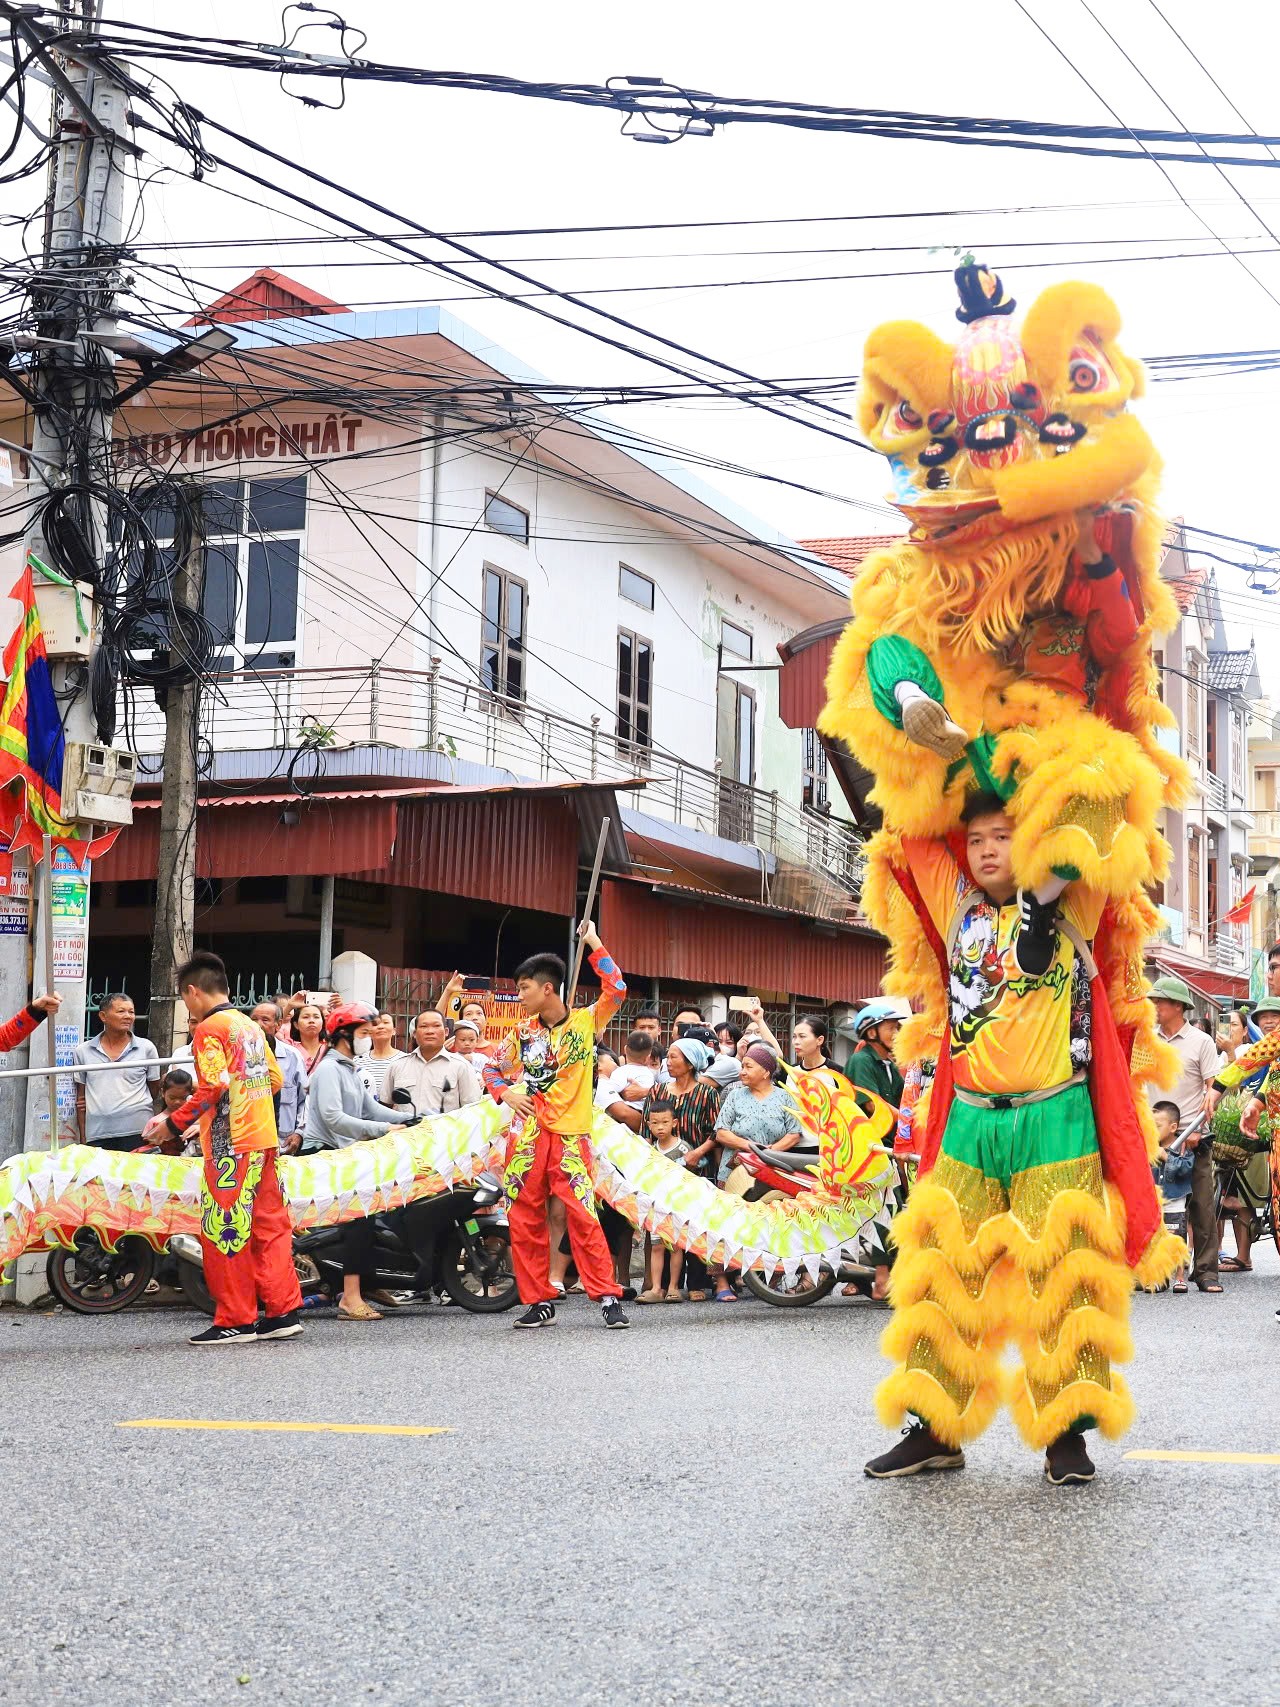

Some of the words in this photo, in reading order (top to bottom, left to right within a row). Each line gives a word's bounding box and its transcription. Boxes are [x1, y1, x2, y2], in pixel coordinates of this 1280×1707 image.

[176, 419, 275, 464] THỐNG
[280, 411, 362, 457] NHẤT
[11, 869, 28, 879] YÊN
[53, 939, 67, 951] IỆT
[217, 1156, 236, 1188] 2
